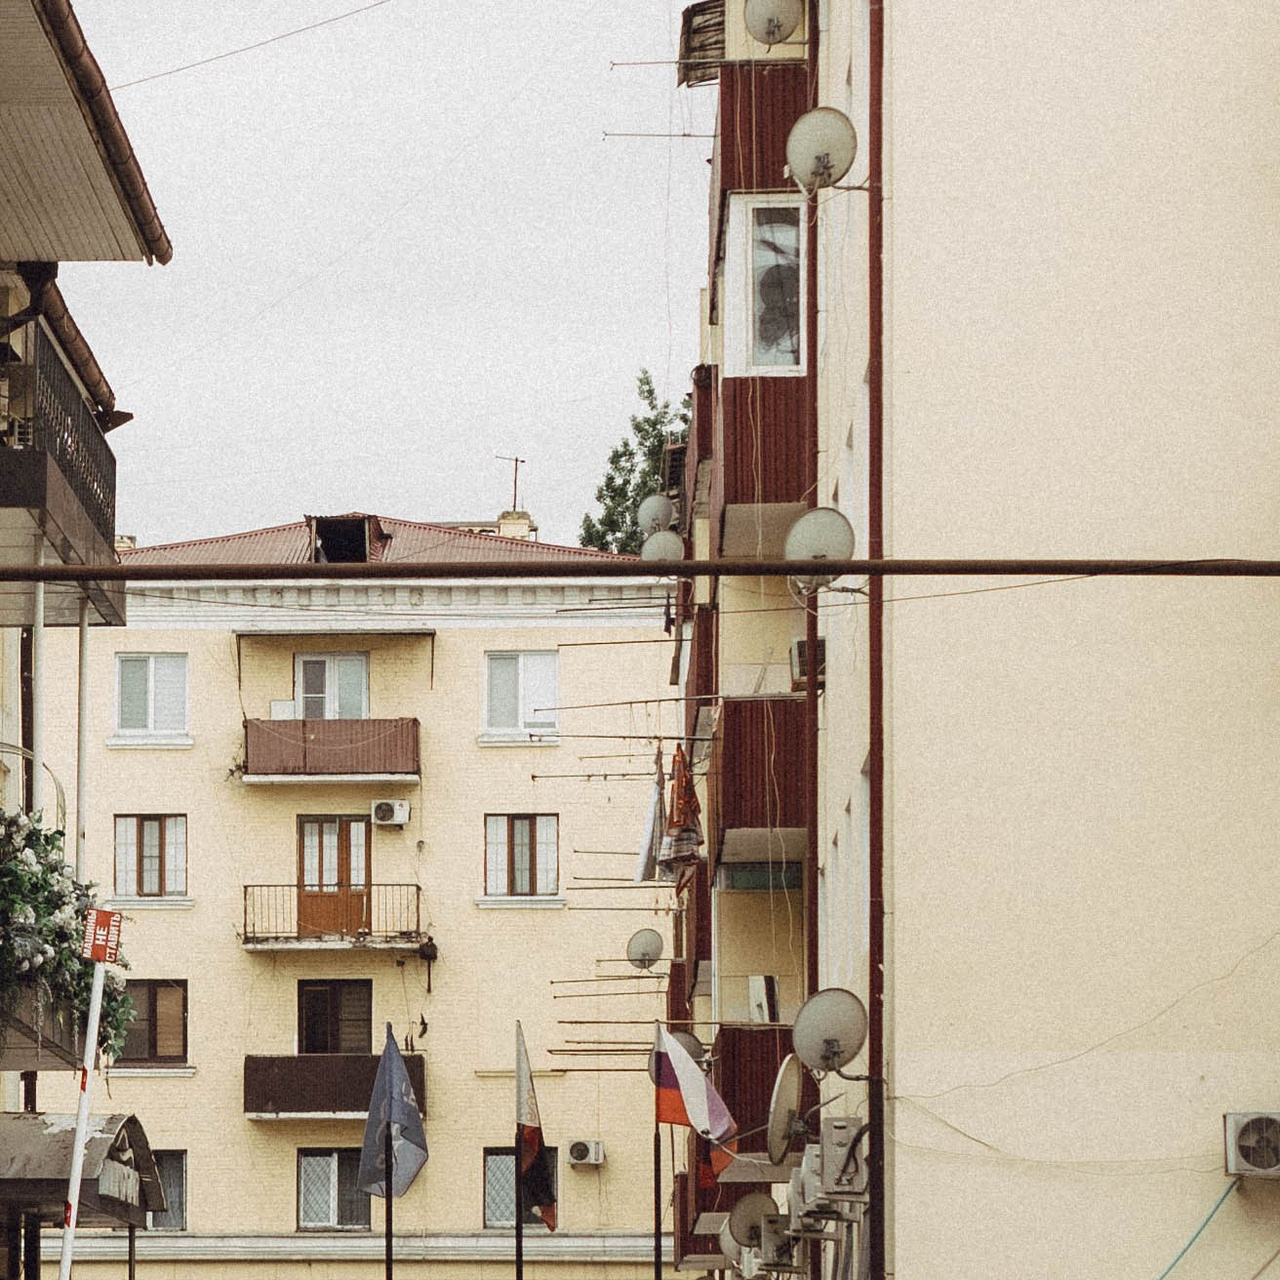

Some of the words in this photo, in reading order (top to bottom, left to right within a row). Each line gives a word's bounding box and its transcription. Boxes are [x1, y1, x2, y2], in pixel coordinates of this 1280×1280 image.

[82, 909, 97, 958] МАШИНЫ
[95, 925, 108, 946] НЕ
[105, 913, 121, 962] СТАВИТЬ
